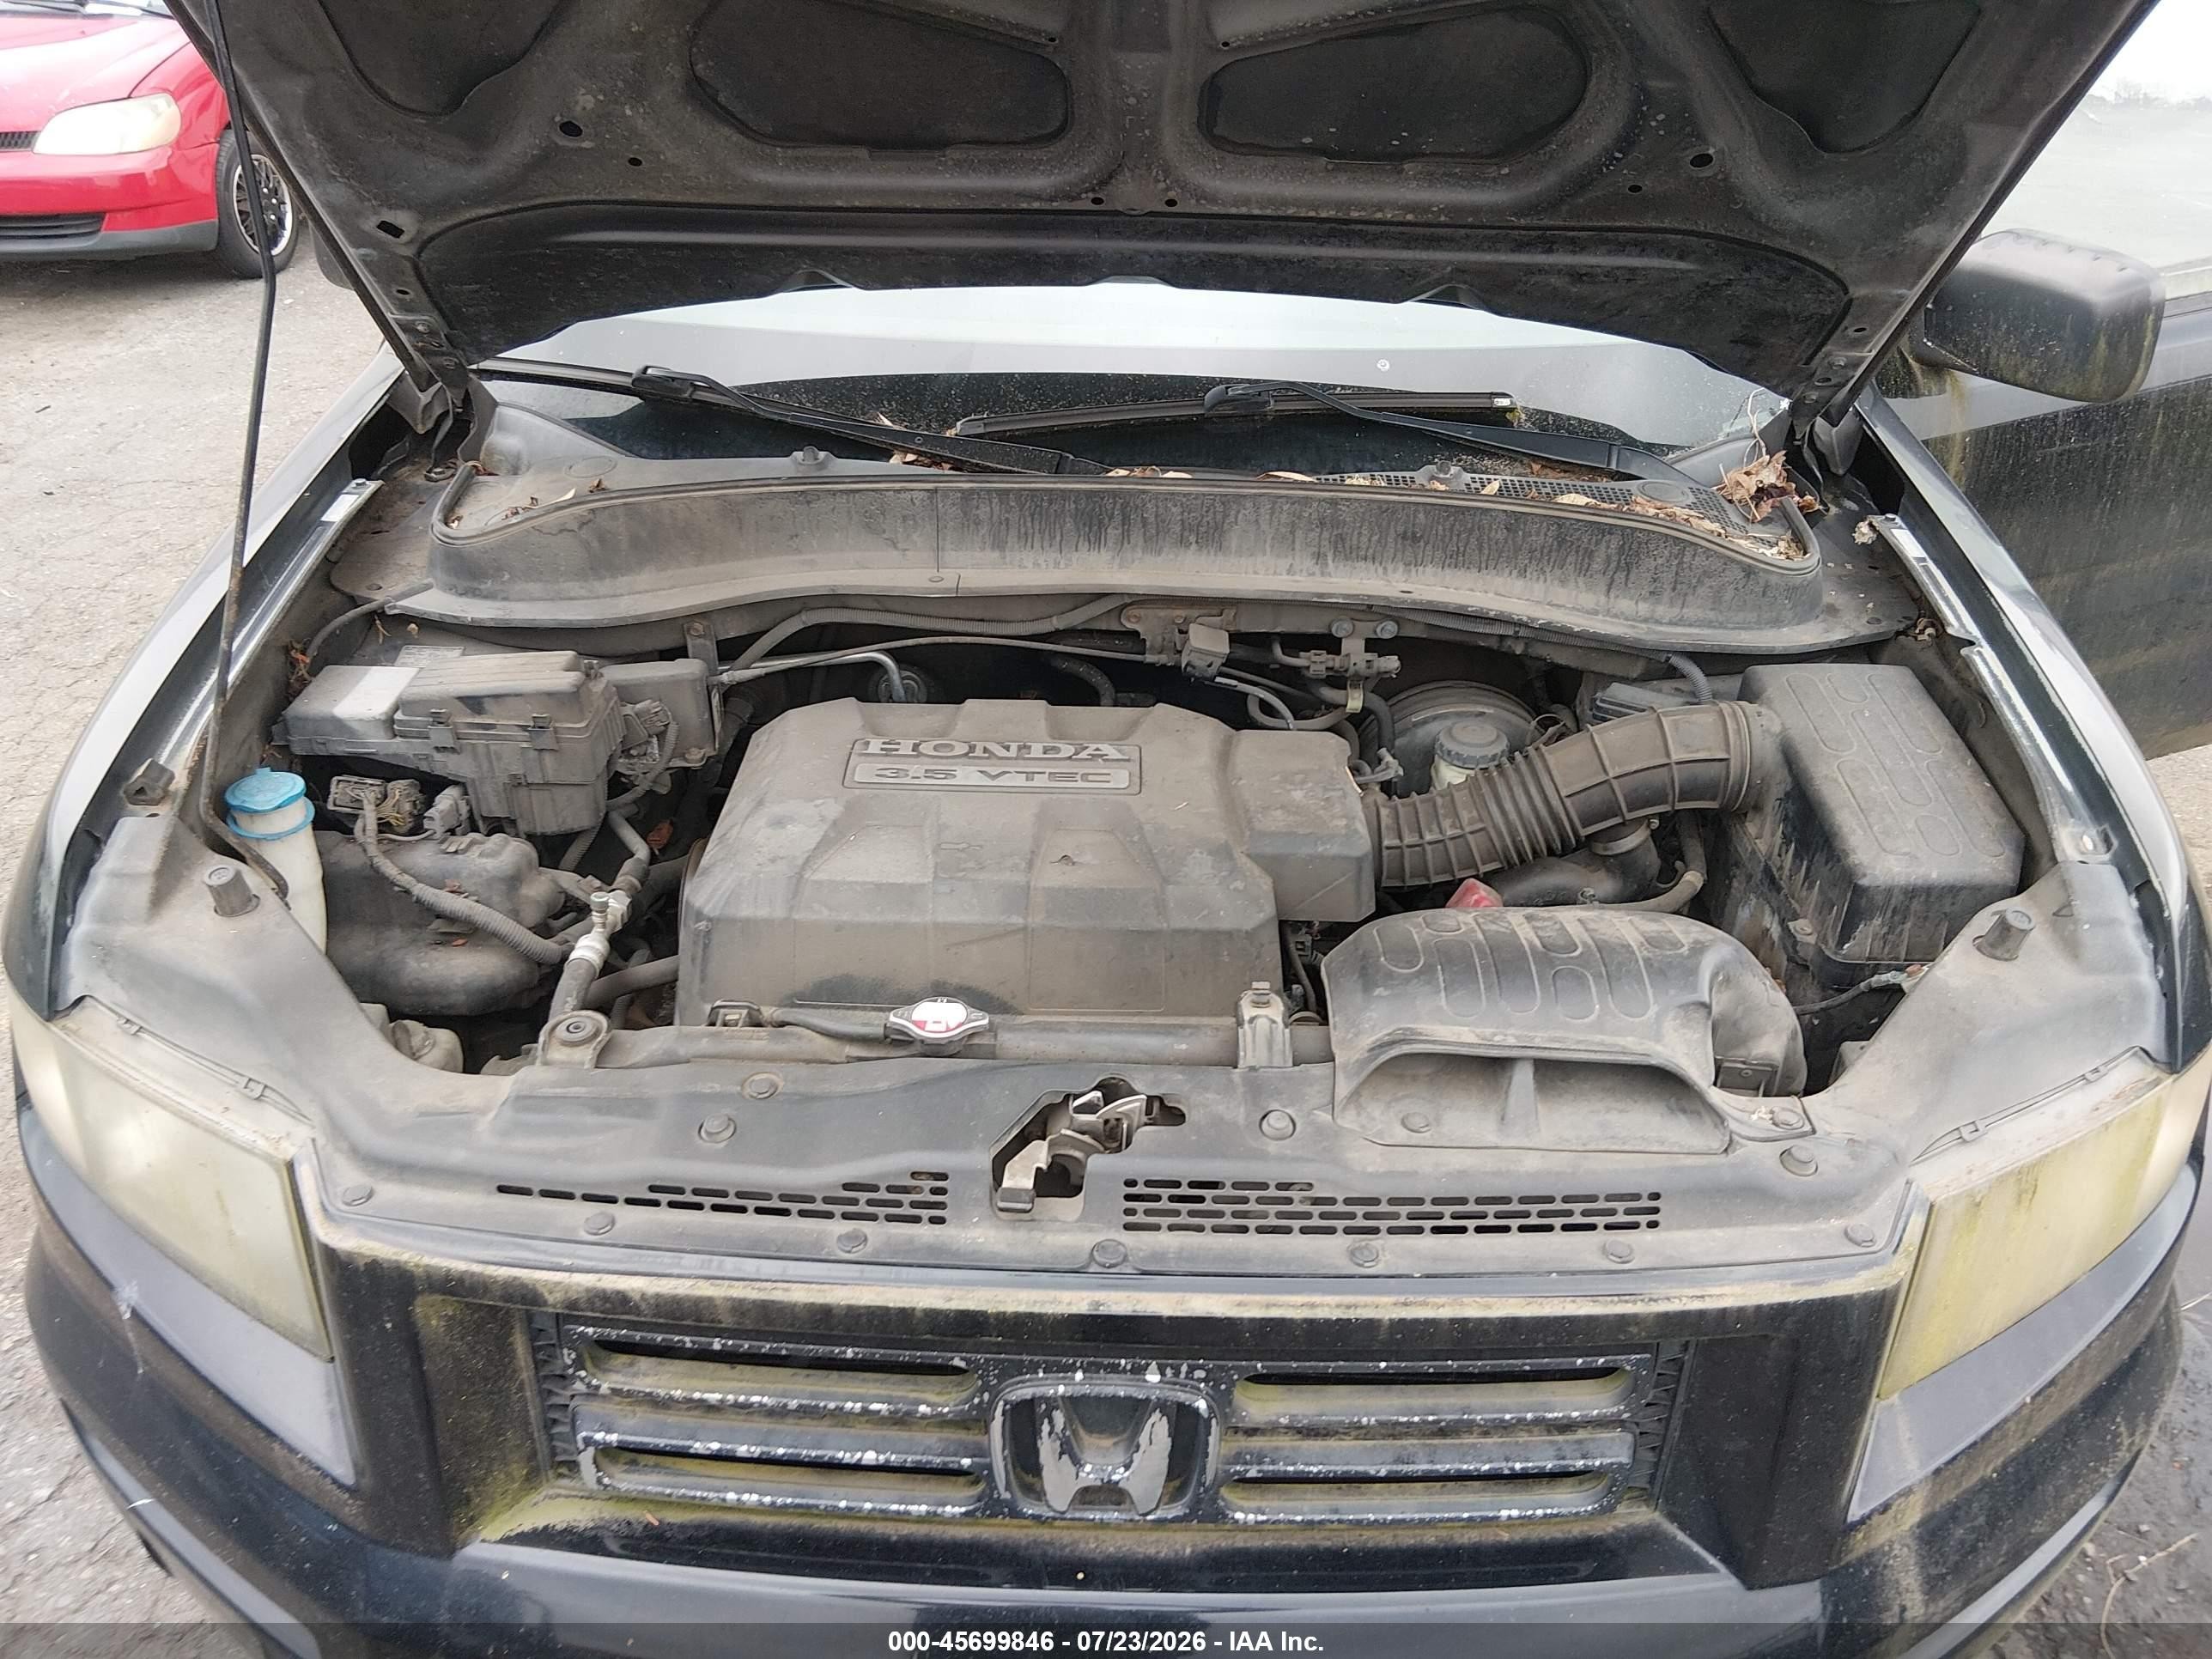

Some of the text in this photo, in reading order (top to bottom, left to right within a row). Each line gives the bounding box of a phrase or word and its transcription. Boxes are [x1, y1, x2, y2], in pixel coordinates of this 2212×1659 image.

[861, 738, 1131, 762] HONDA
[874, 766, 1113, 784] 3.5 VTEC
